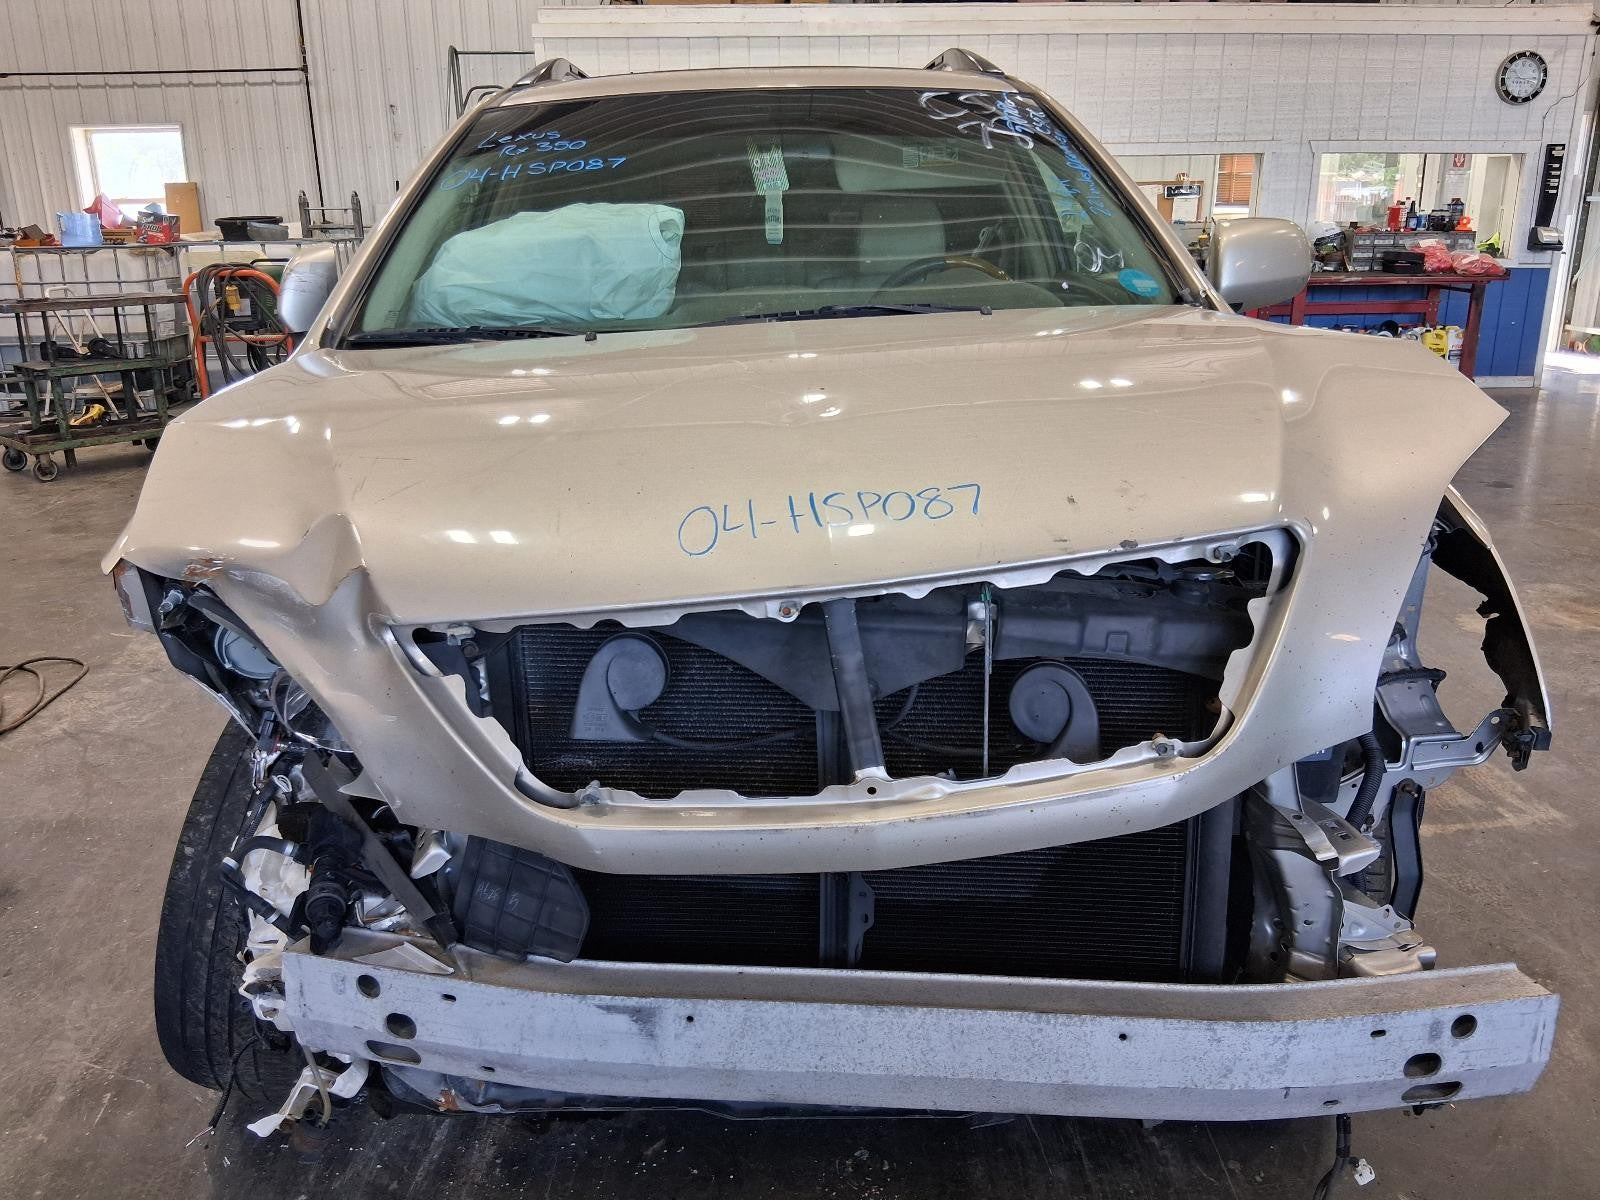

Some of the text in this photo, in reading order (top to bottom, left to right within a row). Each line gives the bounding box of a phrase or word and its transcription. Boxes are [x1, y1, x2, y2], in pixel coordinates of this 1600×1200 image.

[477, 130, 561, 149] Lexus
[536, 140, 587, 152] 350
[678, 483, 981, 556] 04-HSP087
